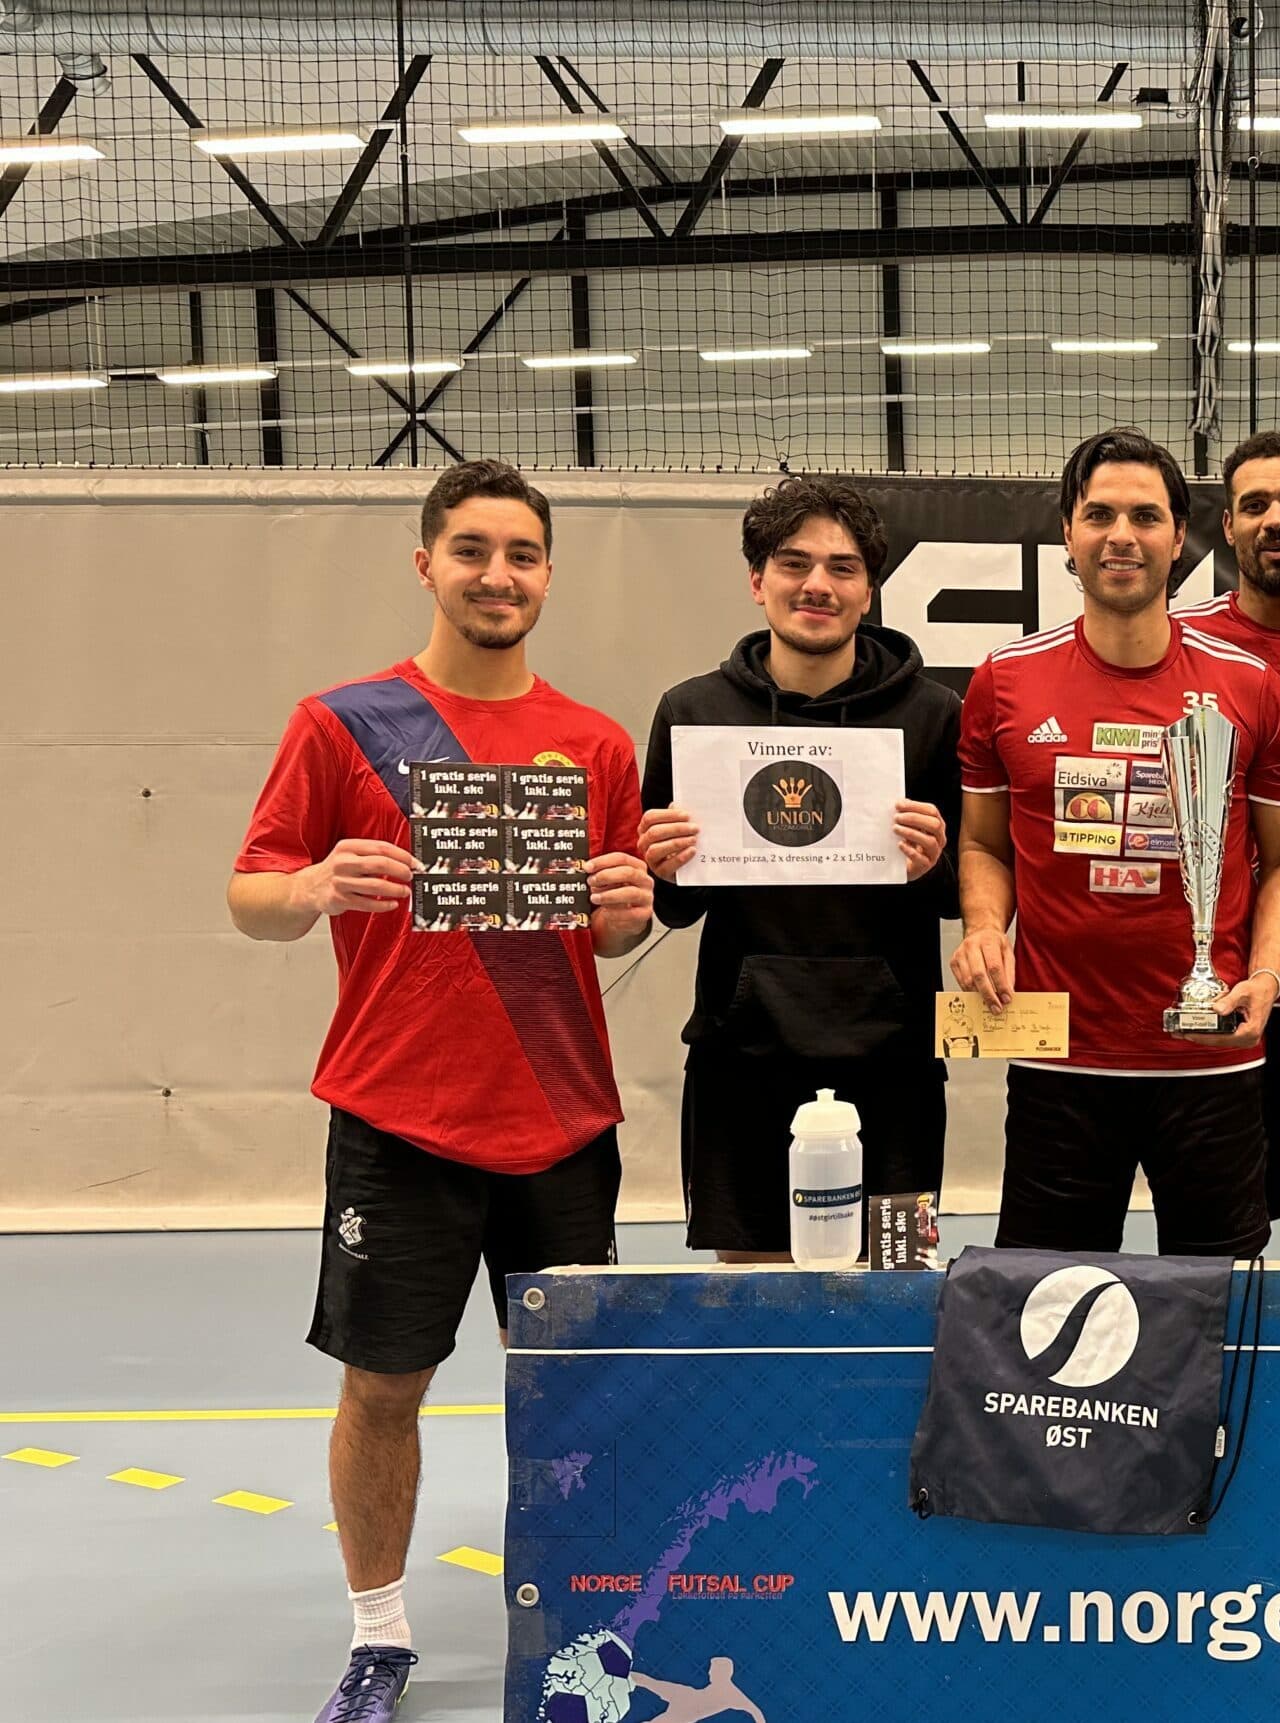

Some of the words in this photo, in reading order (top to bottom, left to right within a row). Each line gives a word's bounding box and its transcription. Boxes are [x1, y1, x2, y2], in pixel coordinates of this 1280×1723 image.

[1183, 691, 1218, 714] 35
[1027, 734, 1068, 743] adidas
[1096, 727, 1140, 747] KIWI
[747, 741, 804, 756] Vinner
[809, 745, 833, 756] av:
[1142, 739, 1158, 749] pris
[421, 770, 426, 780] 1
[429, 771, 464, 783] gratis
[467, 772, 497, 782] serie
[511, 772, 517, 782] 1
[519, 774, 553, 785] gratis
[556, 774, 584, 784] serie
[1058, 772, 1107, 787] Eidsiva
[434, 784, 460, 794] inkl.
[524, 786, 549, 796] inkl.
[767, 811, 823, 825] UNION
[422, 826, 428, 836] 1
[430, 827, 466, 839] gratis
[469, 827, 498, 837] serie
[513, 826, 518, 837] 1
[521, 827, 555, 839] gratis
[557, 828, 586, 837] serie
[1069, 833, 1116, 845] TIPPING
[436, 840, 462, 849] inkl.
[526, 840, 551, 850] inkl.
[743, 855, 768, 864] pizza,
[785, 854, 823, 864] dressing
[866, 853, 886, 861] brus
[423, 882, 429, 892] 1
[432, 882, 467, 894] gratis
[470, 882, 499, 892] serie
[514, 881, 519, 892] 1
[522, 882, 556, 894] gratis
[559, 882, 587, 892] serie
[437, 895, 463, 905] inkl.
[527, 895, 552, 904] inkl.
[984, 1391, 1158, 1428] SPAREBANKEN
[1045, 1424, 1092, 1449] ØST
[570, 1574, 643, 1593] NORGE
[667, 1574, 747, 1593] FUTSAL
[753, 1574, 795, 1593] CUP
